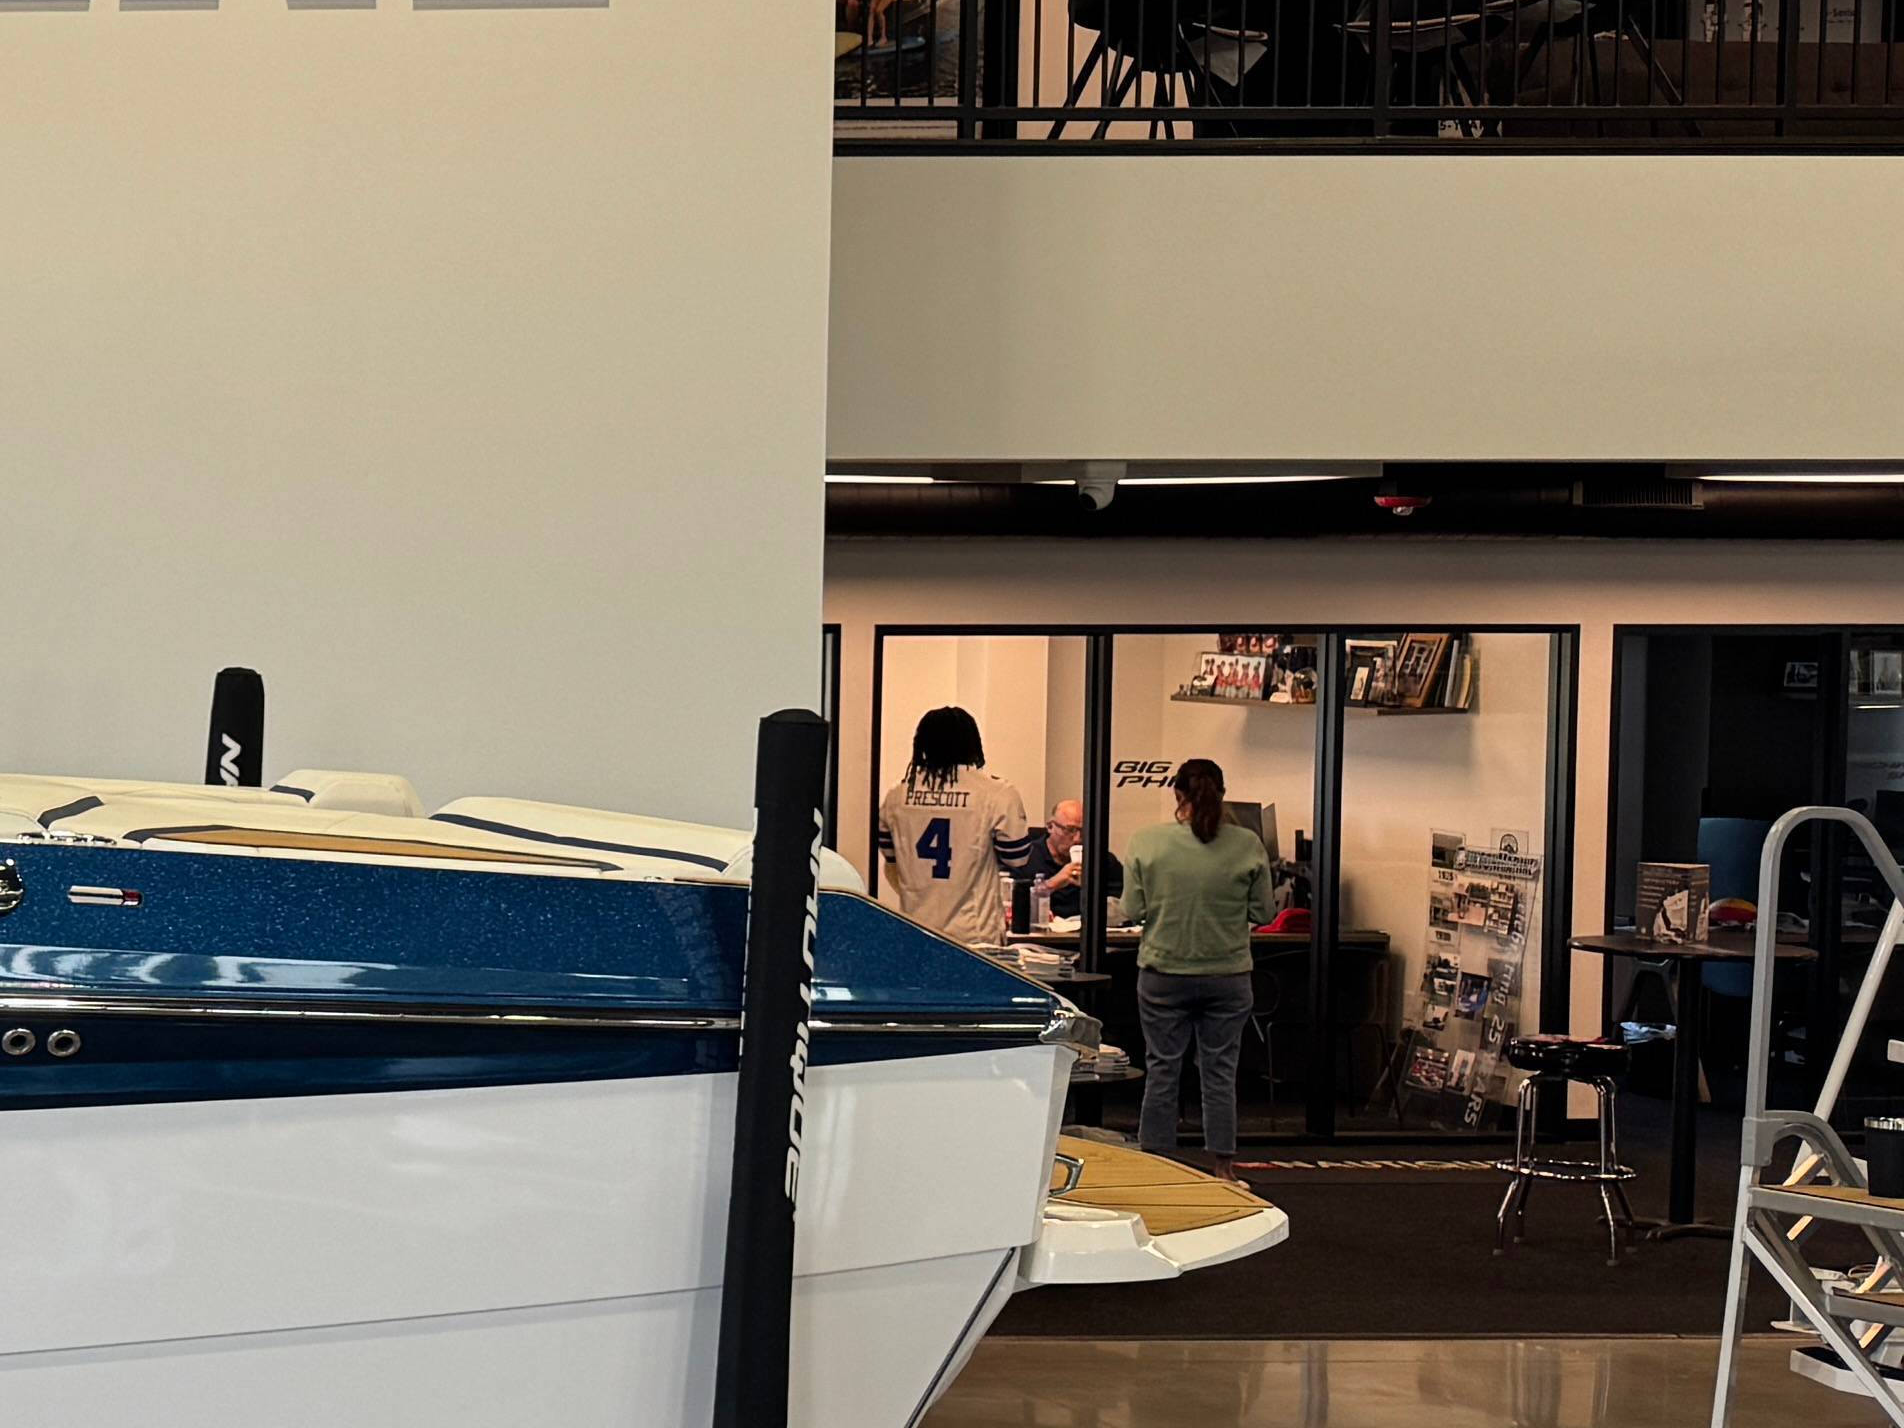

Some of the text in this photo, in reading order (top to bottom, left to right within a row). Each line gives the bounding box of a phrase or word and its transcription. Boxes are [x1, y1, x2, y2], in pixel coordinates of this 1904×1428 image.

[1113, 760, 1173, 774] BIG
[905, 790, 971, 809] PRESCOTT
[915, 817, 953, 880] 4
